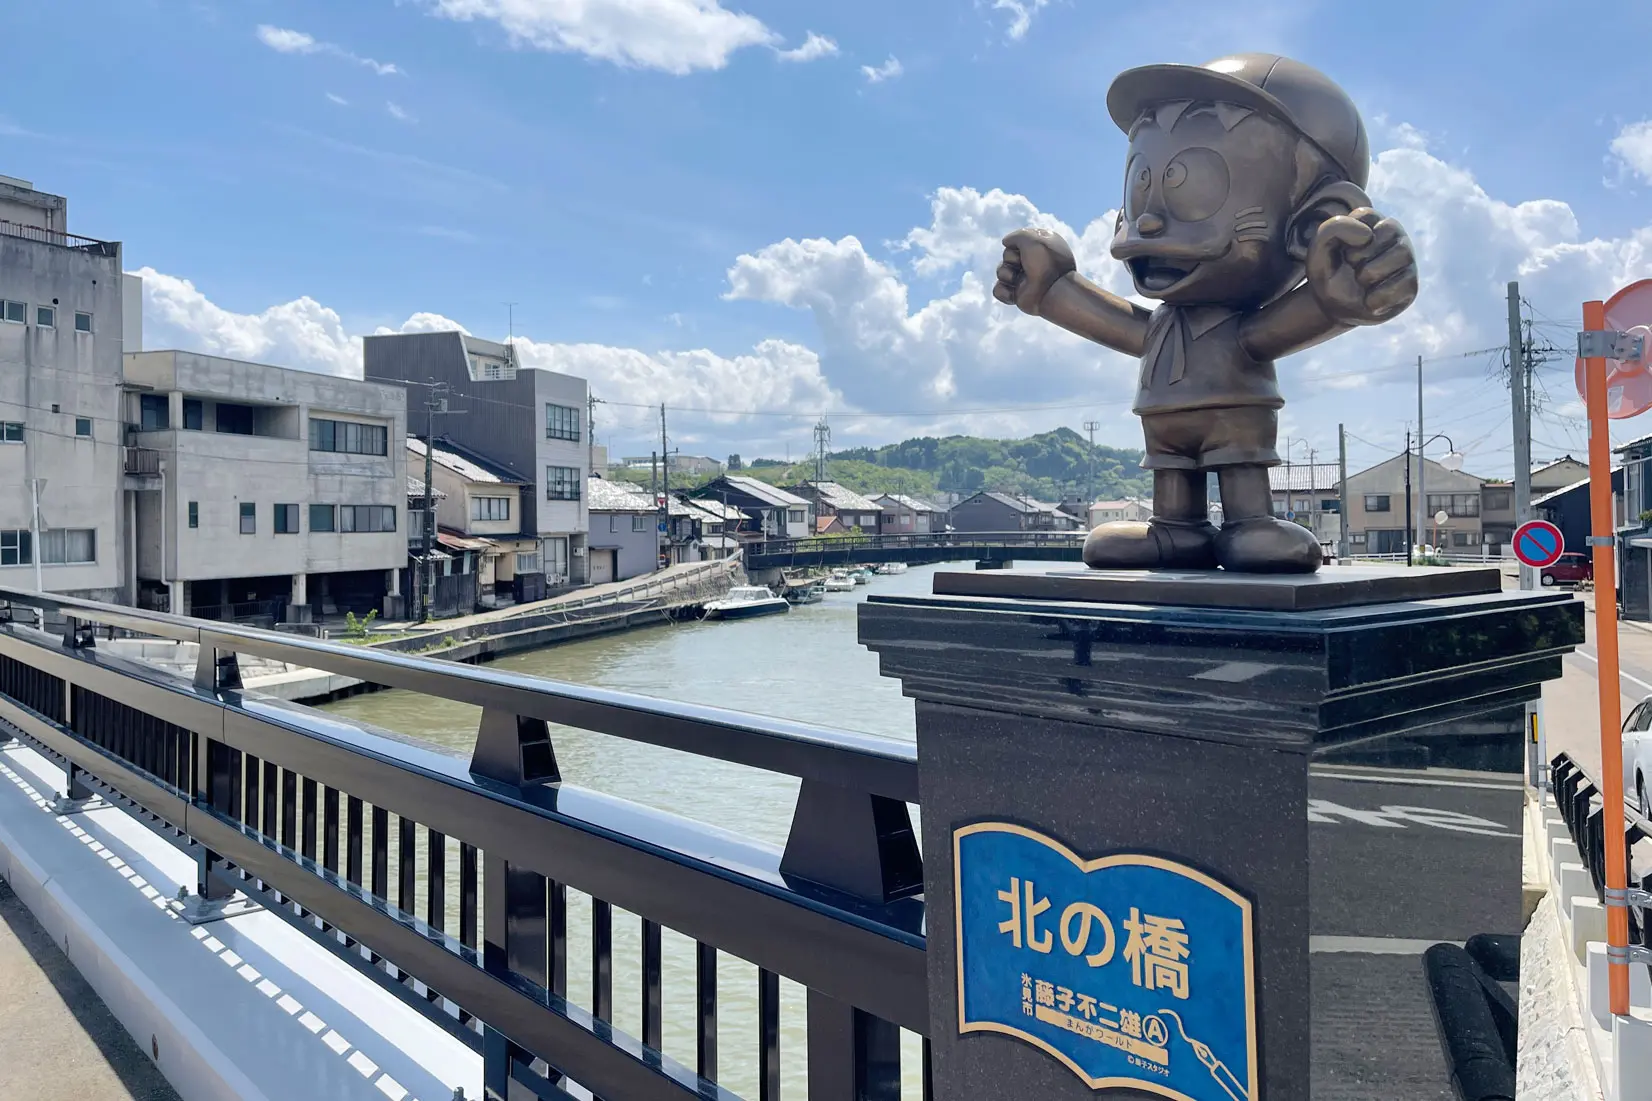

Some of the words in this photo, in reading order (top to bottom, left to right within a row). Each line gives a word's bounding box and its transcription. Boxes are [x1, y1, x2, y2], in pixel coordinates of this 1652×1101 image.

[997, 877, 1190, 1000] 北の橋
[1020, 972, 1033, 1016] 氷見市
